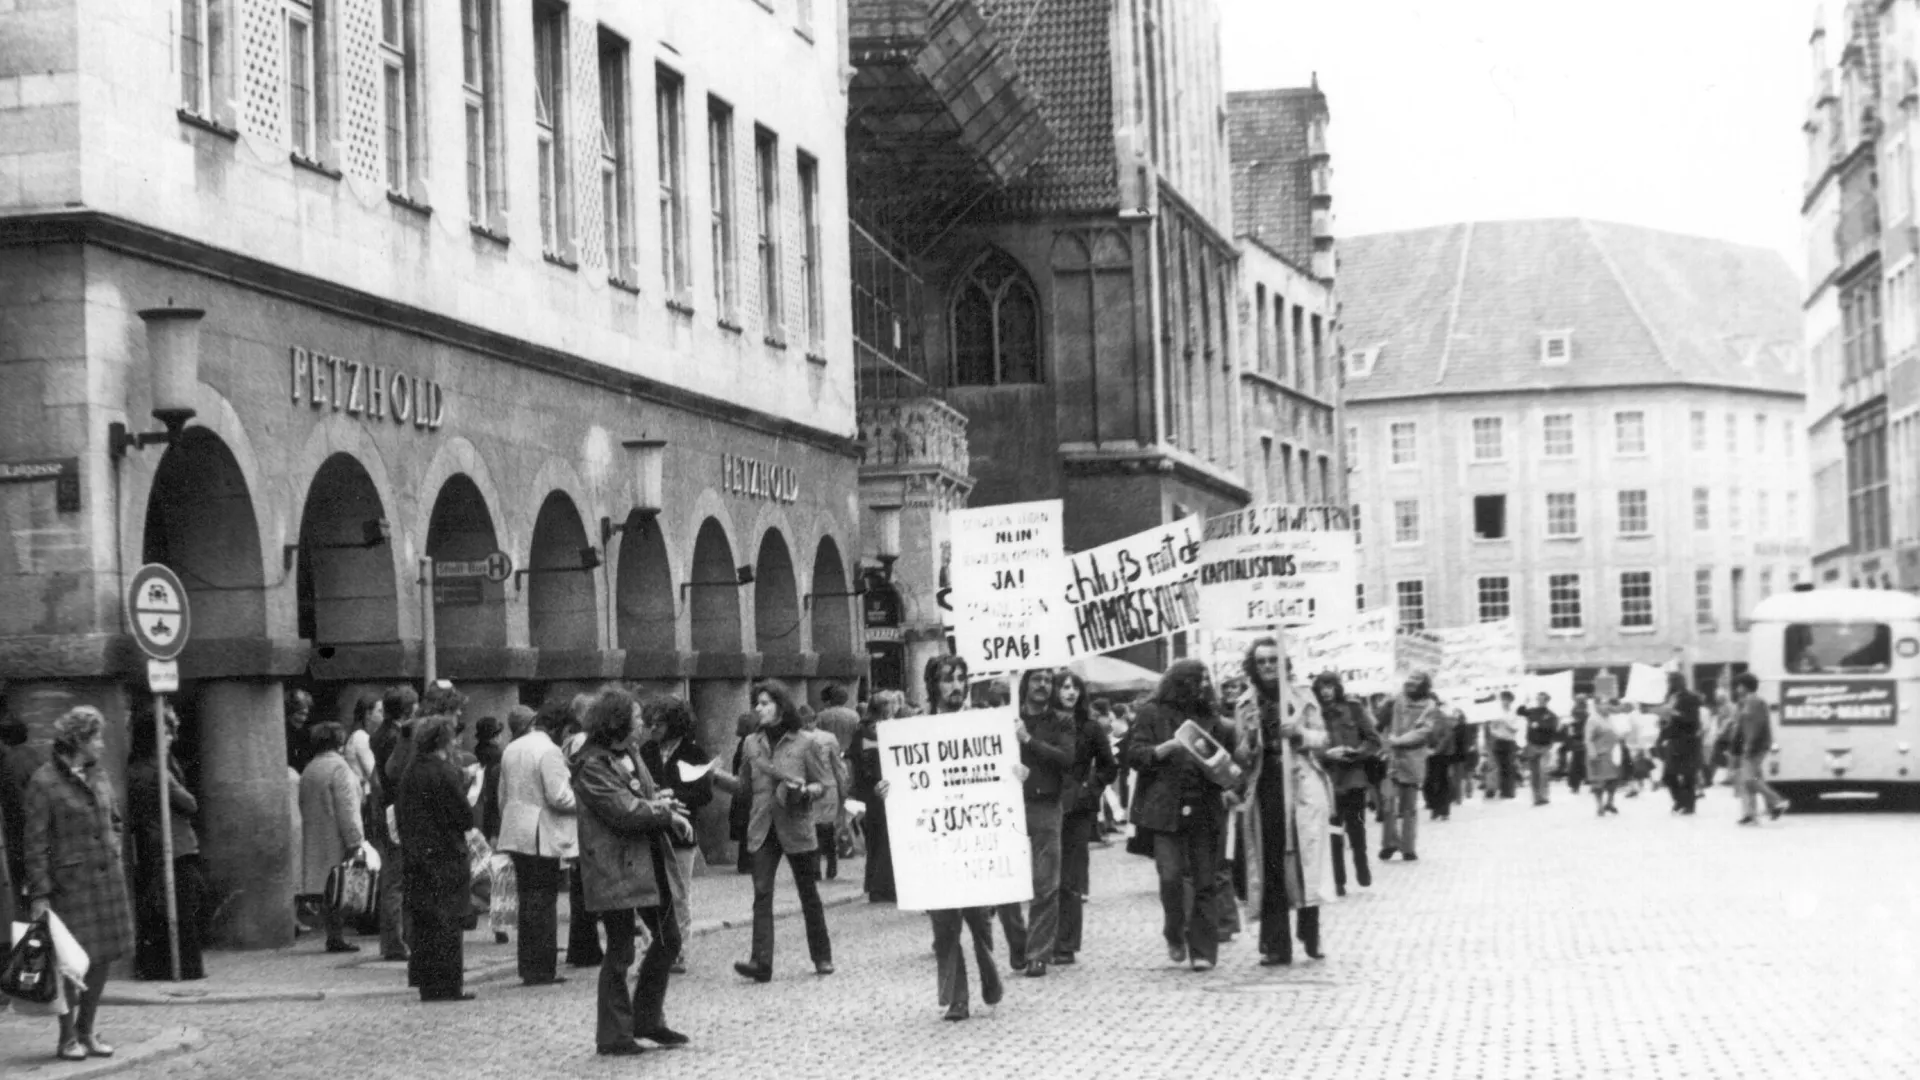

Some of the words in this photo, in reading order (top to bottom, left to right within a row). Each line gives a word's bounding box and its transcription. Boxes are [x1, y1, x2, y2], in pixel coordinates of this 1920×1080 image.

[290, 345, 444, 429] PETZHOLD
[721, 453, 799, 505] PETZHOLD
[489, 557, 505, 577] H
[991, 568, 1025, 590] JA!
[1201, 554, 1297, 585] KAPITALISMUS
[889, 742, 931, 767] TUST
[938, 740, 960, 762] DU
[963, 734, 1003, 760] AUCH
[910, 771, 930, 790] SO
